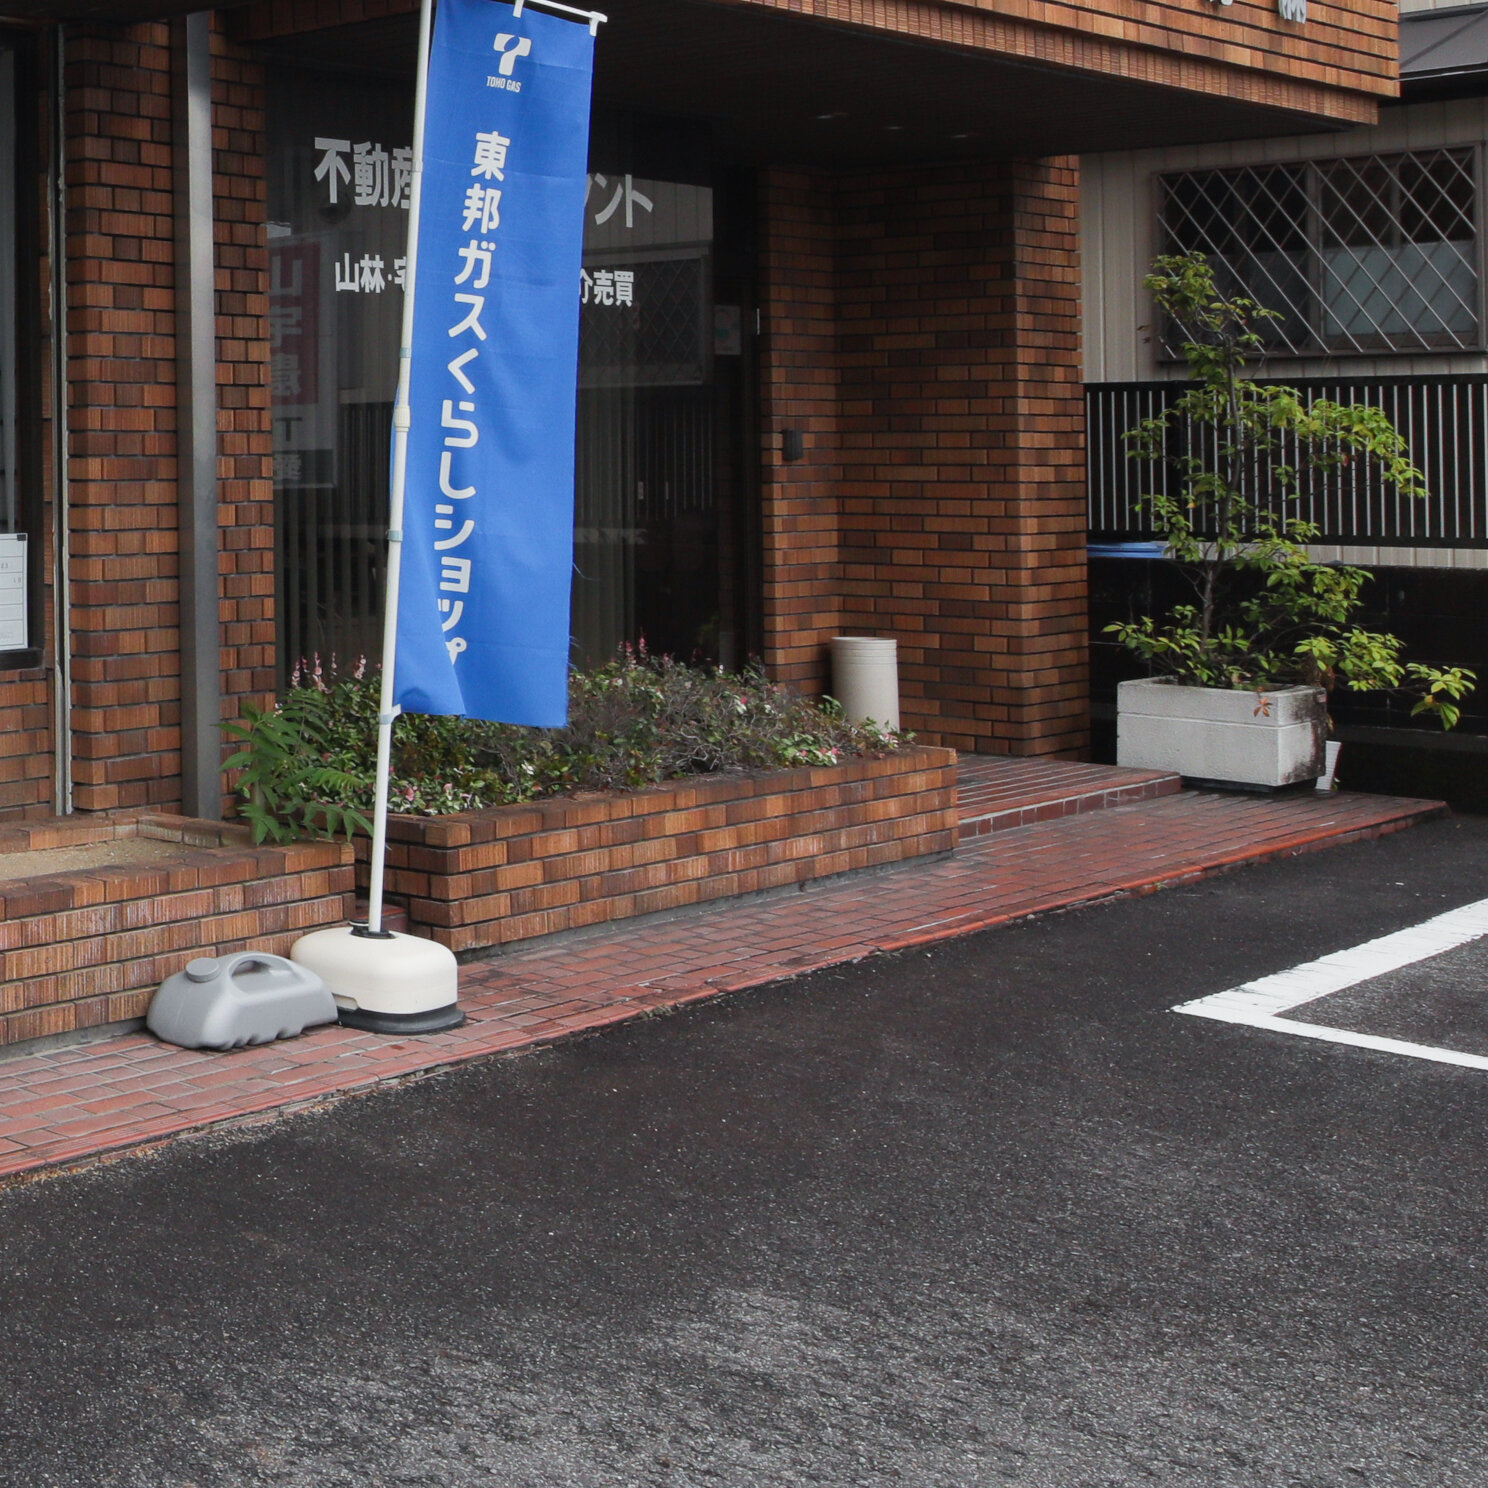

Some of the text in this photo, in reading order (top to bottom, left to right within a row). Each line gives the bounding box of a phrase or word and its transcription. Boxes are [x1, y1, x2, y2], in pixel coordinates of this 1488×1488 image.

[486, 75, 522, 93] TOHO GAS
[584, 173, 654, 228] ント
